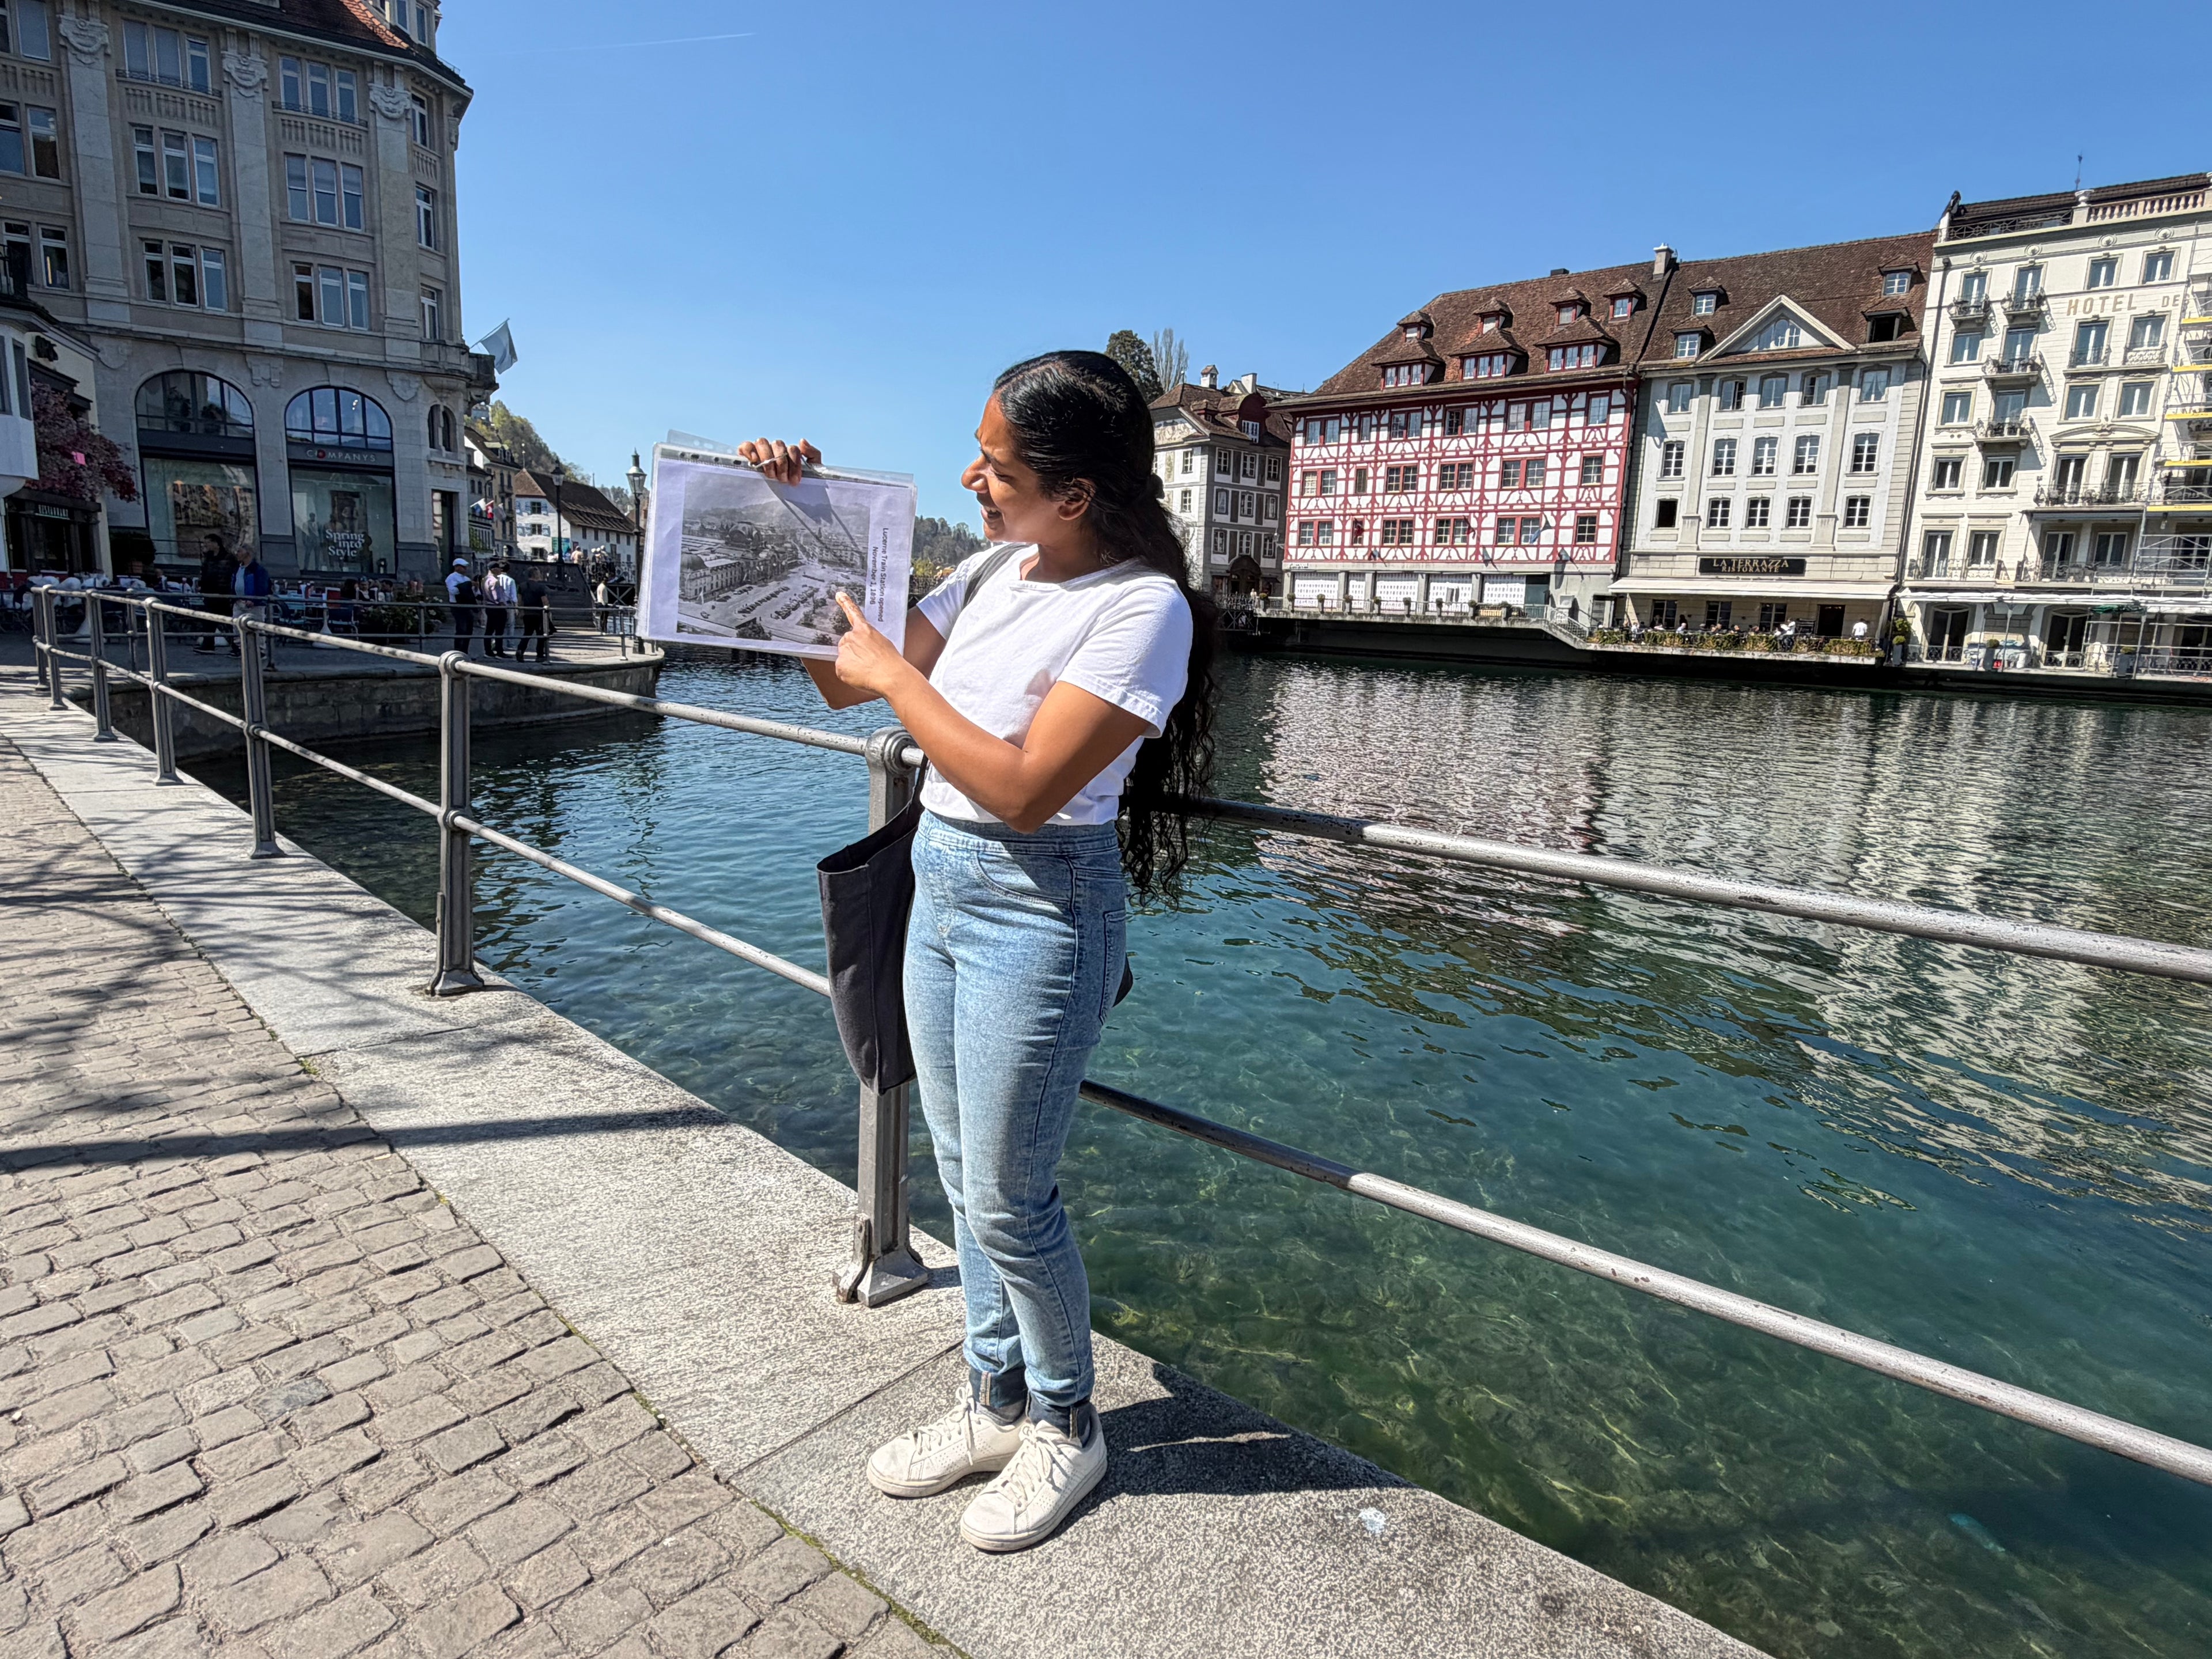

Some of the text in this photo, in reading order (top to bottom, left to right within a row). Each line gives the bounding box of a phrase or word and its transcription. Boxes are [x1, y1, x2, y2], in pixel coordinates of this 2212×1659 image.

[2067, 294, 2137, 316] HOTEL
[307, 449, 376, 461] COMPANYS
[325, 529, 365, 543] Spring
[338, 539, 363, 548] into
[328, 546, 358, 560] Style
[870, 547, 878, 581] November
[1713, 559, 1789, 568] LA TERRAZZA
